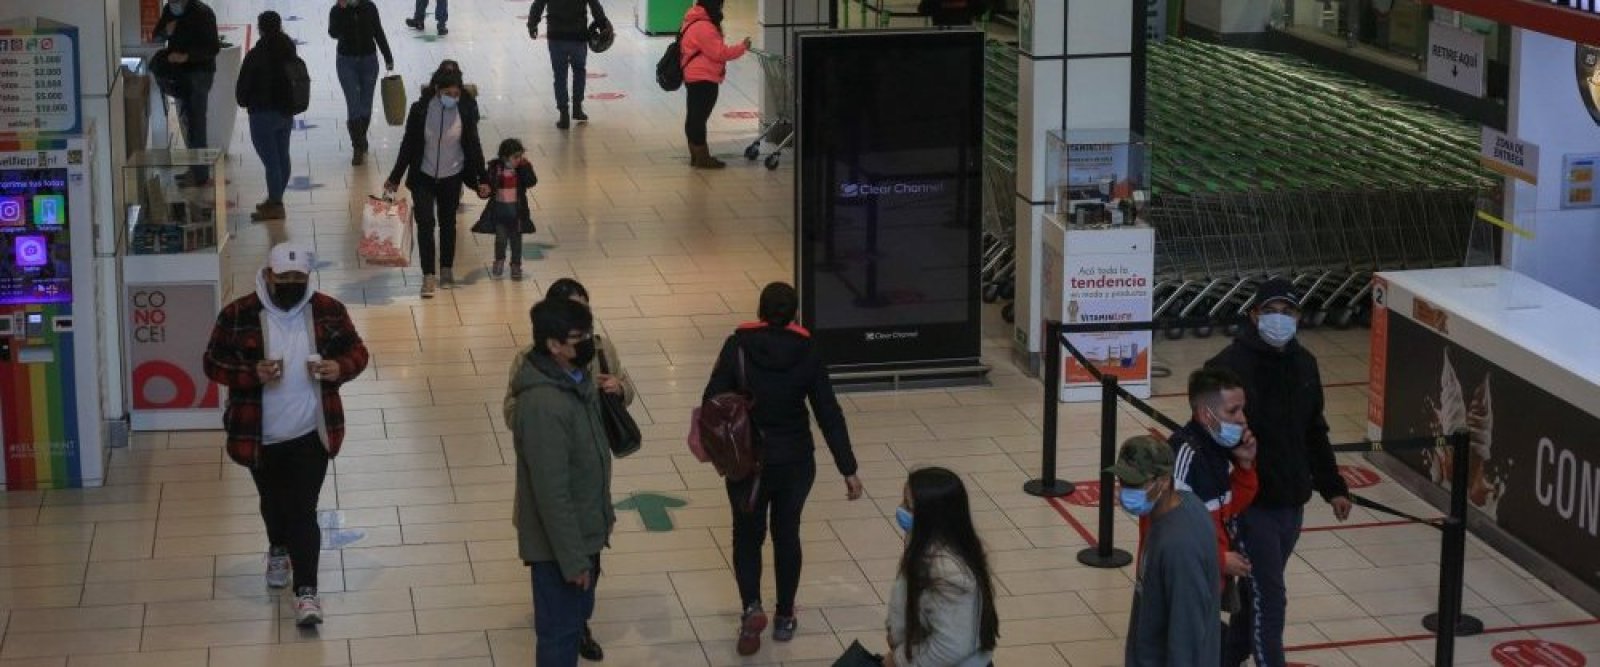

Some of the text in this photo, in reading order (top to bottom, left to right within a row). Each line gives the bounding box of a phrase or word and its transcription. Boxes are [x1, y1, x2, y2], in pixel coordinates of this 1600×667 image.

[1432, 44, 1457, 62] RETIRE
[1494, 147, 1524, 167] ENTREGA
[860, 181, 944, 194] Clear Channel
[1097, 265, 1117, 275] toda
[1071, 273, 1147, 289] tendencia
[133, 290, 166, 308] CO
[1375, 287, 1383, 304] 2
[133, 308, 166, 325] NO
